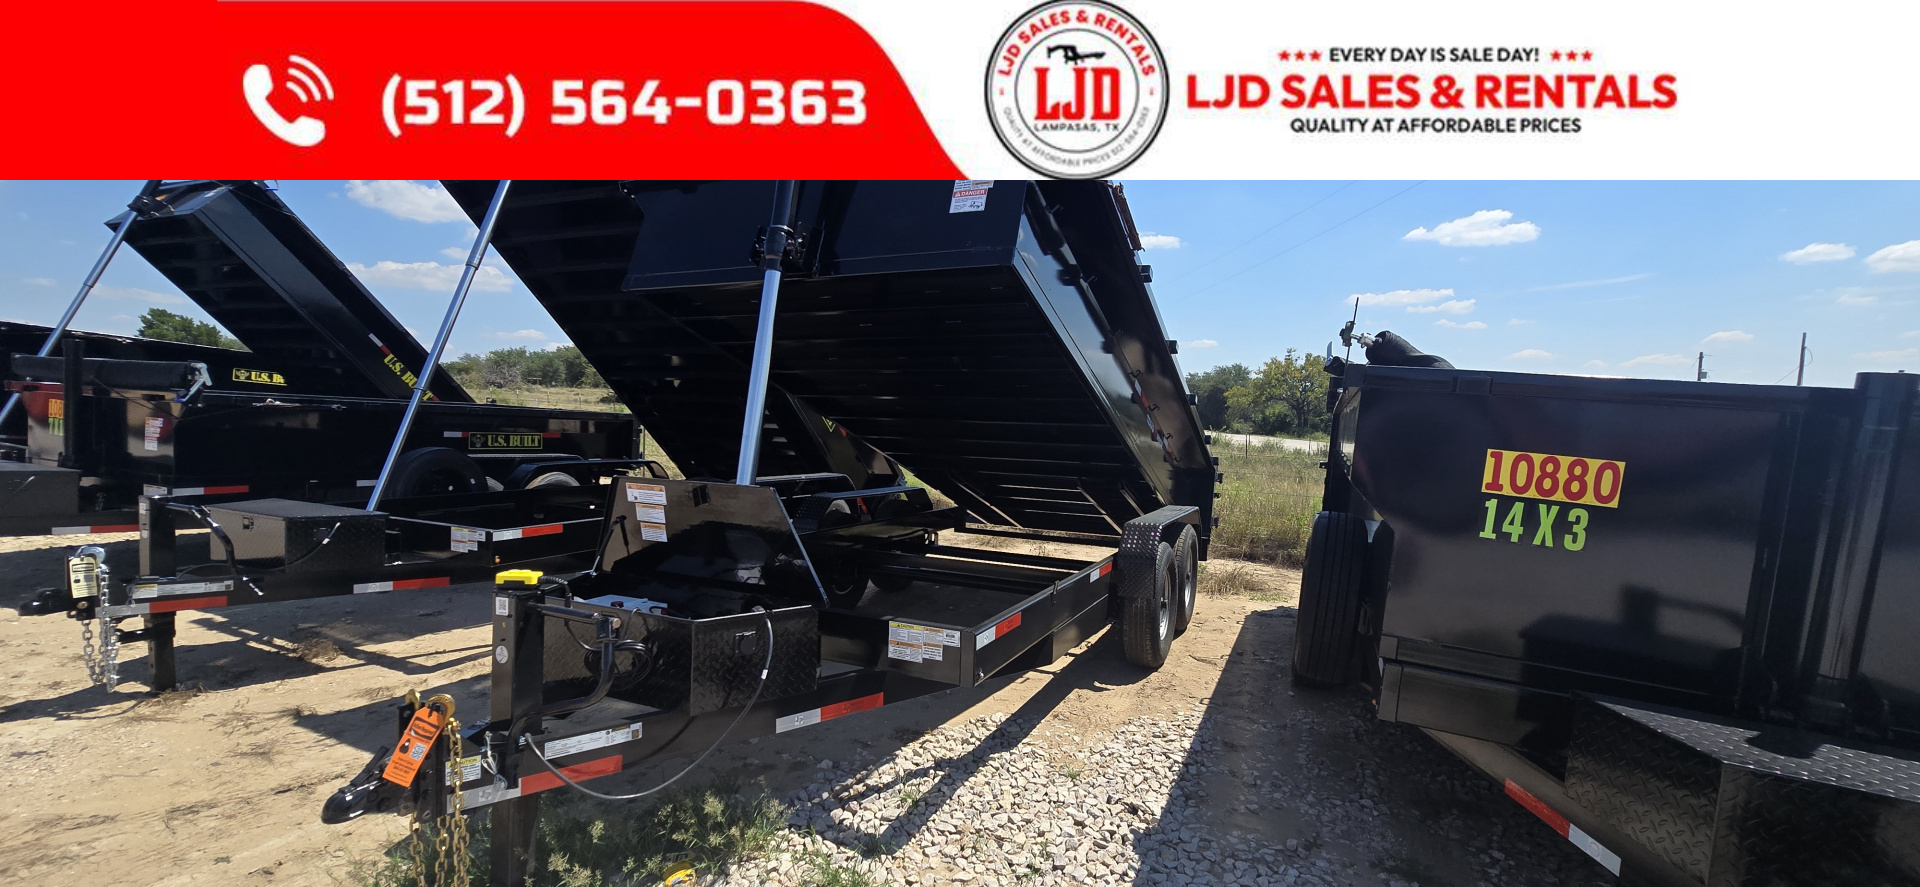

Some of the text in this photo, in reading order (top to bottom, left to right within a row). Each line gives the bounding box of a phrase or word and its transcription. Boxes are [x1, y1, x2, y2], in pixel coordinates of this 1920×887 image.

[250, 371, 271, 382] U.S.
[384, 353, 434, 401] U.S. BUT
[487, 434, 541, 447] U.S. BUILT
[1485, 451, 1621, 504] 10880
[1479, 498, 1589, 551] 14 X 3
